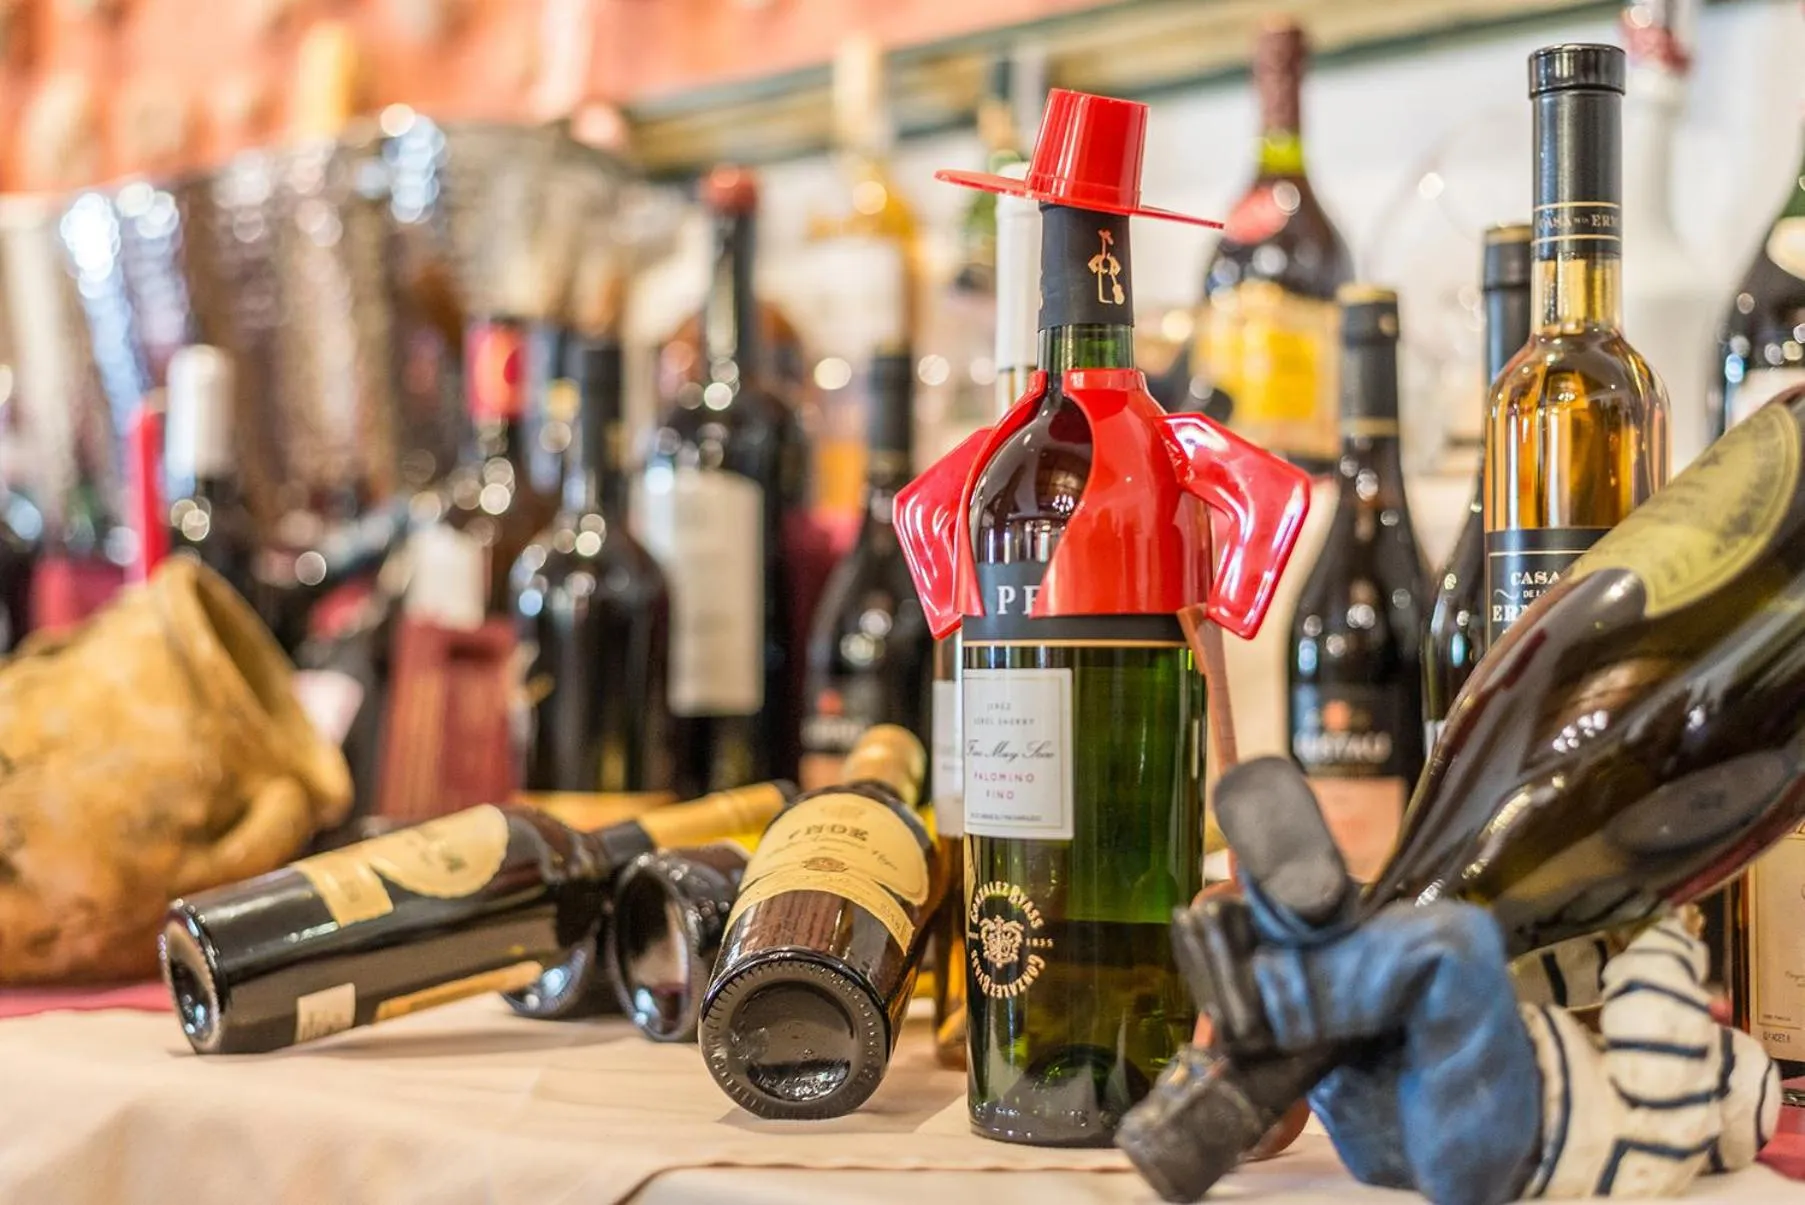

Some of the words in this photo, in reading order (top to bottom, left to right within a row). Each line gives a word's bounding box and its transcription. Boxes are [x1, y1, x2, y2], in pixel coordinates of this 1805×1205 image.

[1523, 590, 1534, 598] DE
[973, 771, 1035, 783] PALOMINO
[985, 789, 1015, 800] FINO
